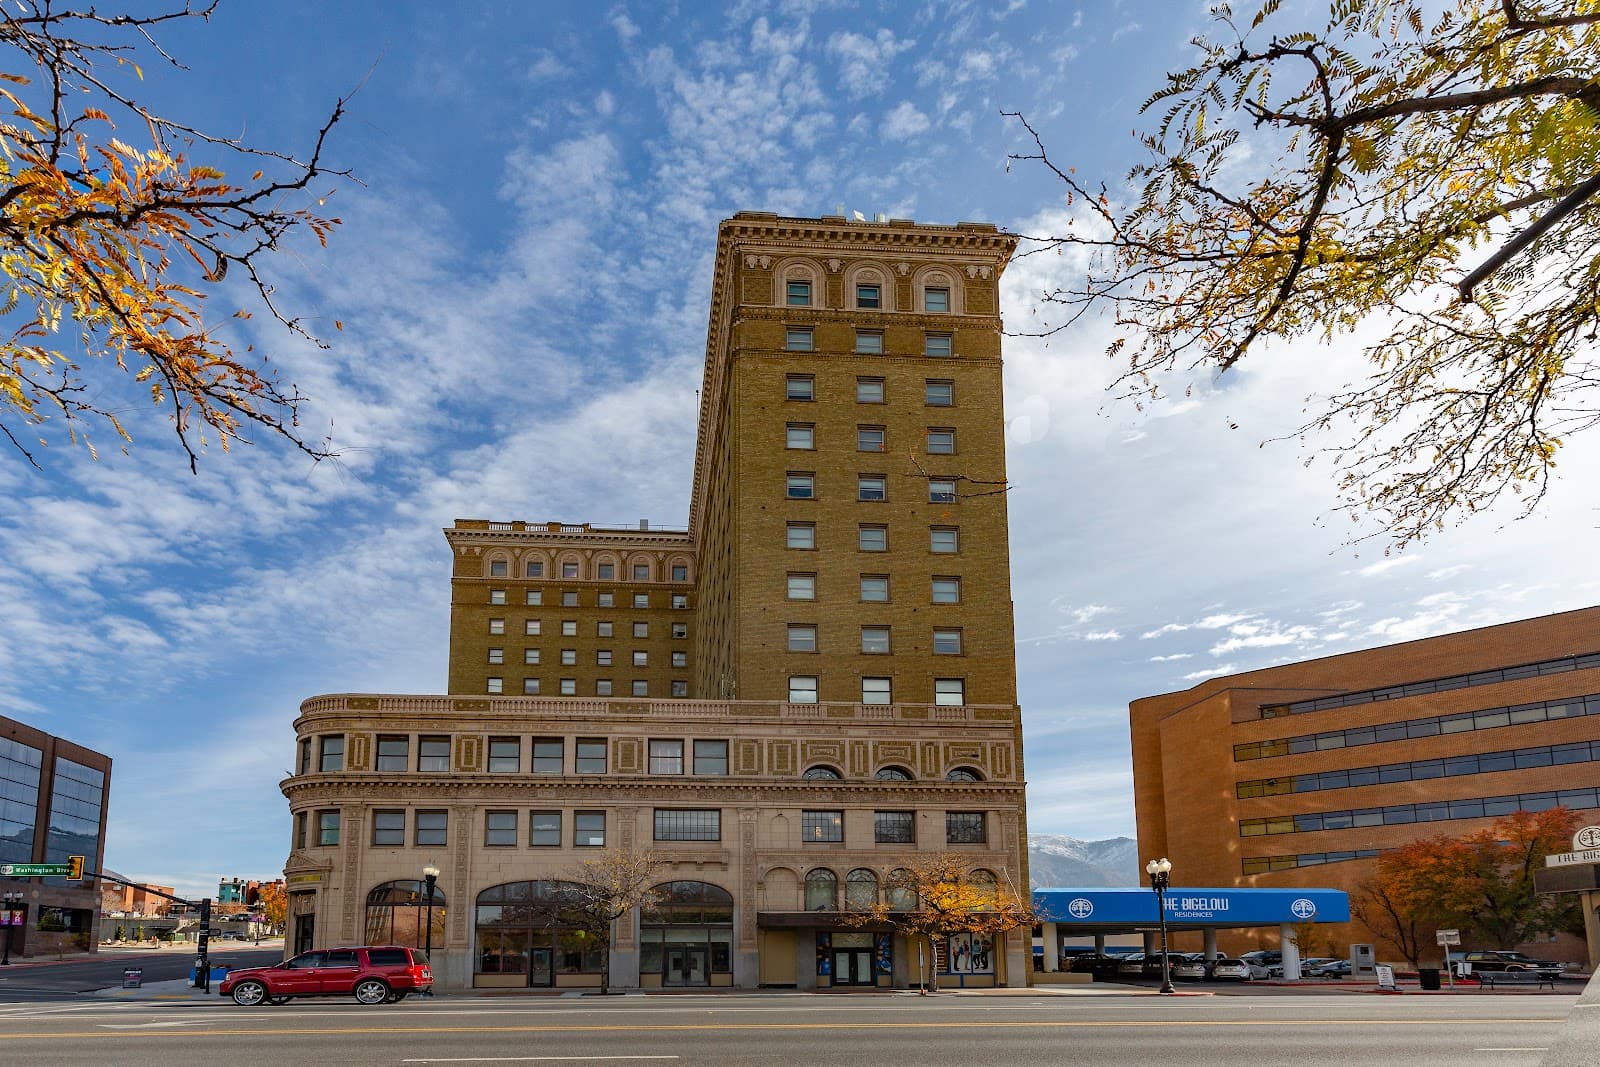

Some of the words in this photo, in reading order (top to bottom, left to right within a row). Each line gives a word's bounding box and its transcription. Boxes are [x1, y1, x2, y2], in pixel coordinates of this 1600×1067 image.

[1558, 853, 1578, 863] THE
[15, 867, 54, 875] Washington
[1181, 897, 1229, 911] BIGELOW
